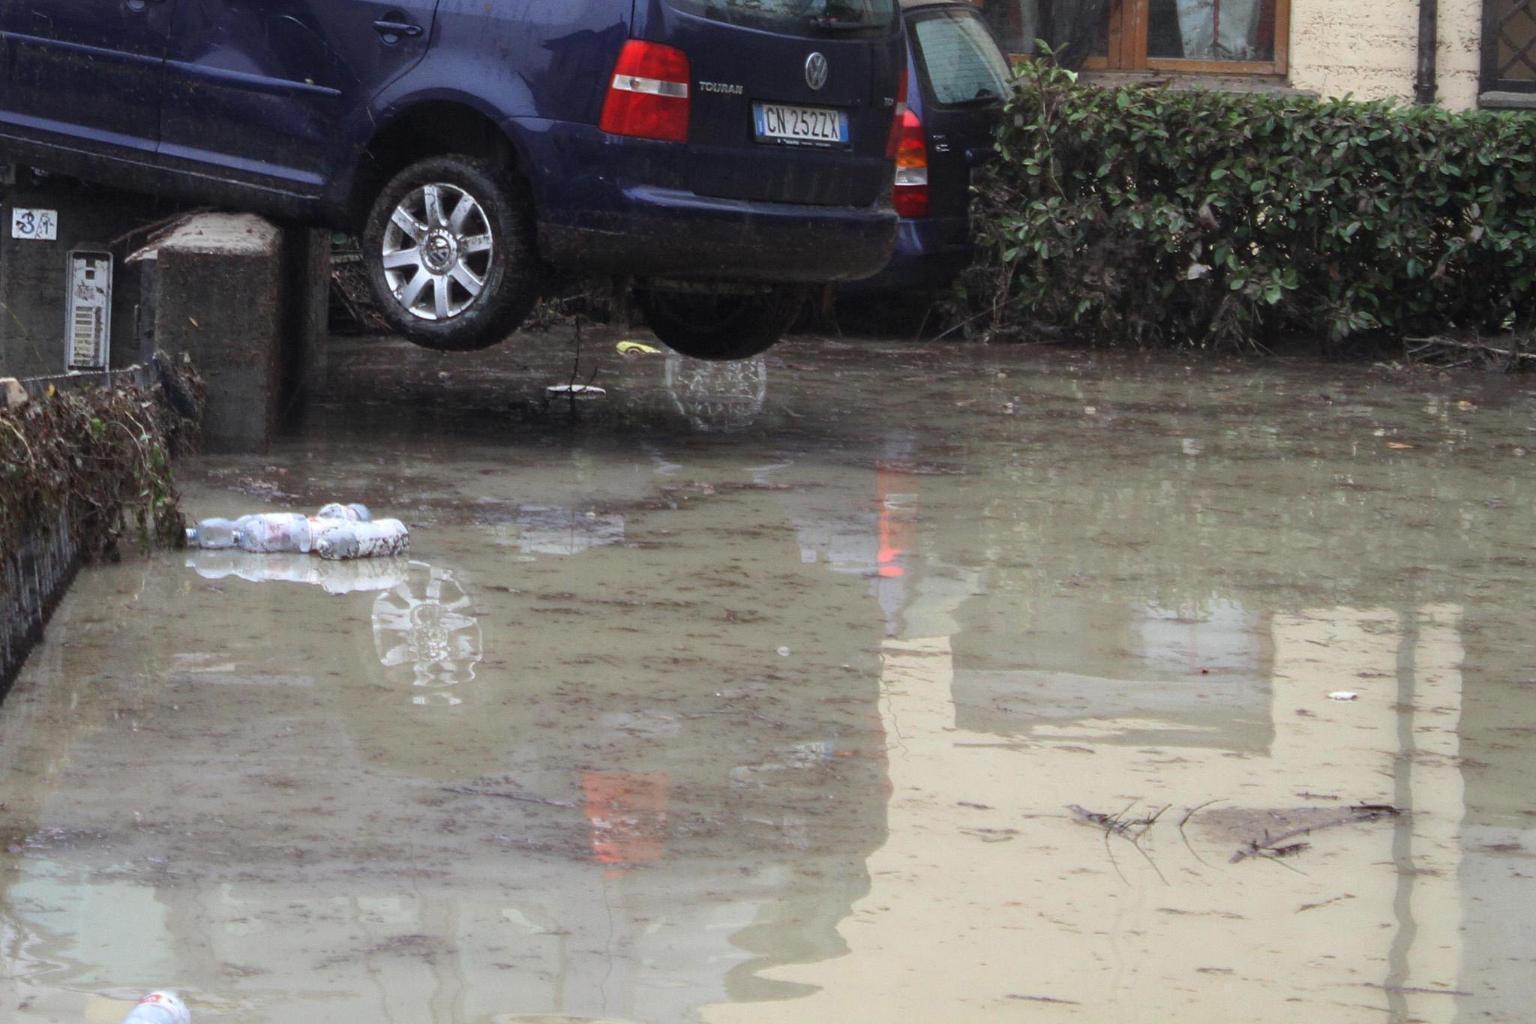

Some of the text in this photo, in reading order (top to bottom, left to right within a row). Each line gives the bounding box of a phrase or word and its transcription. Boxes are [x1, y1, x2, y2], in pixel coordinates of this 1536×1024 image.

[699, 81, 744, 95] TOURAN
[766, 107, 839, 139] CN 252ZX
